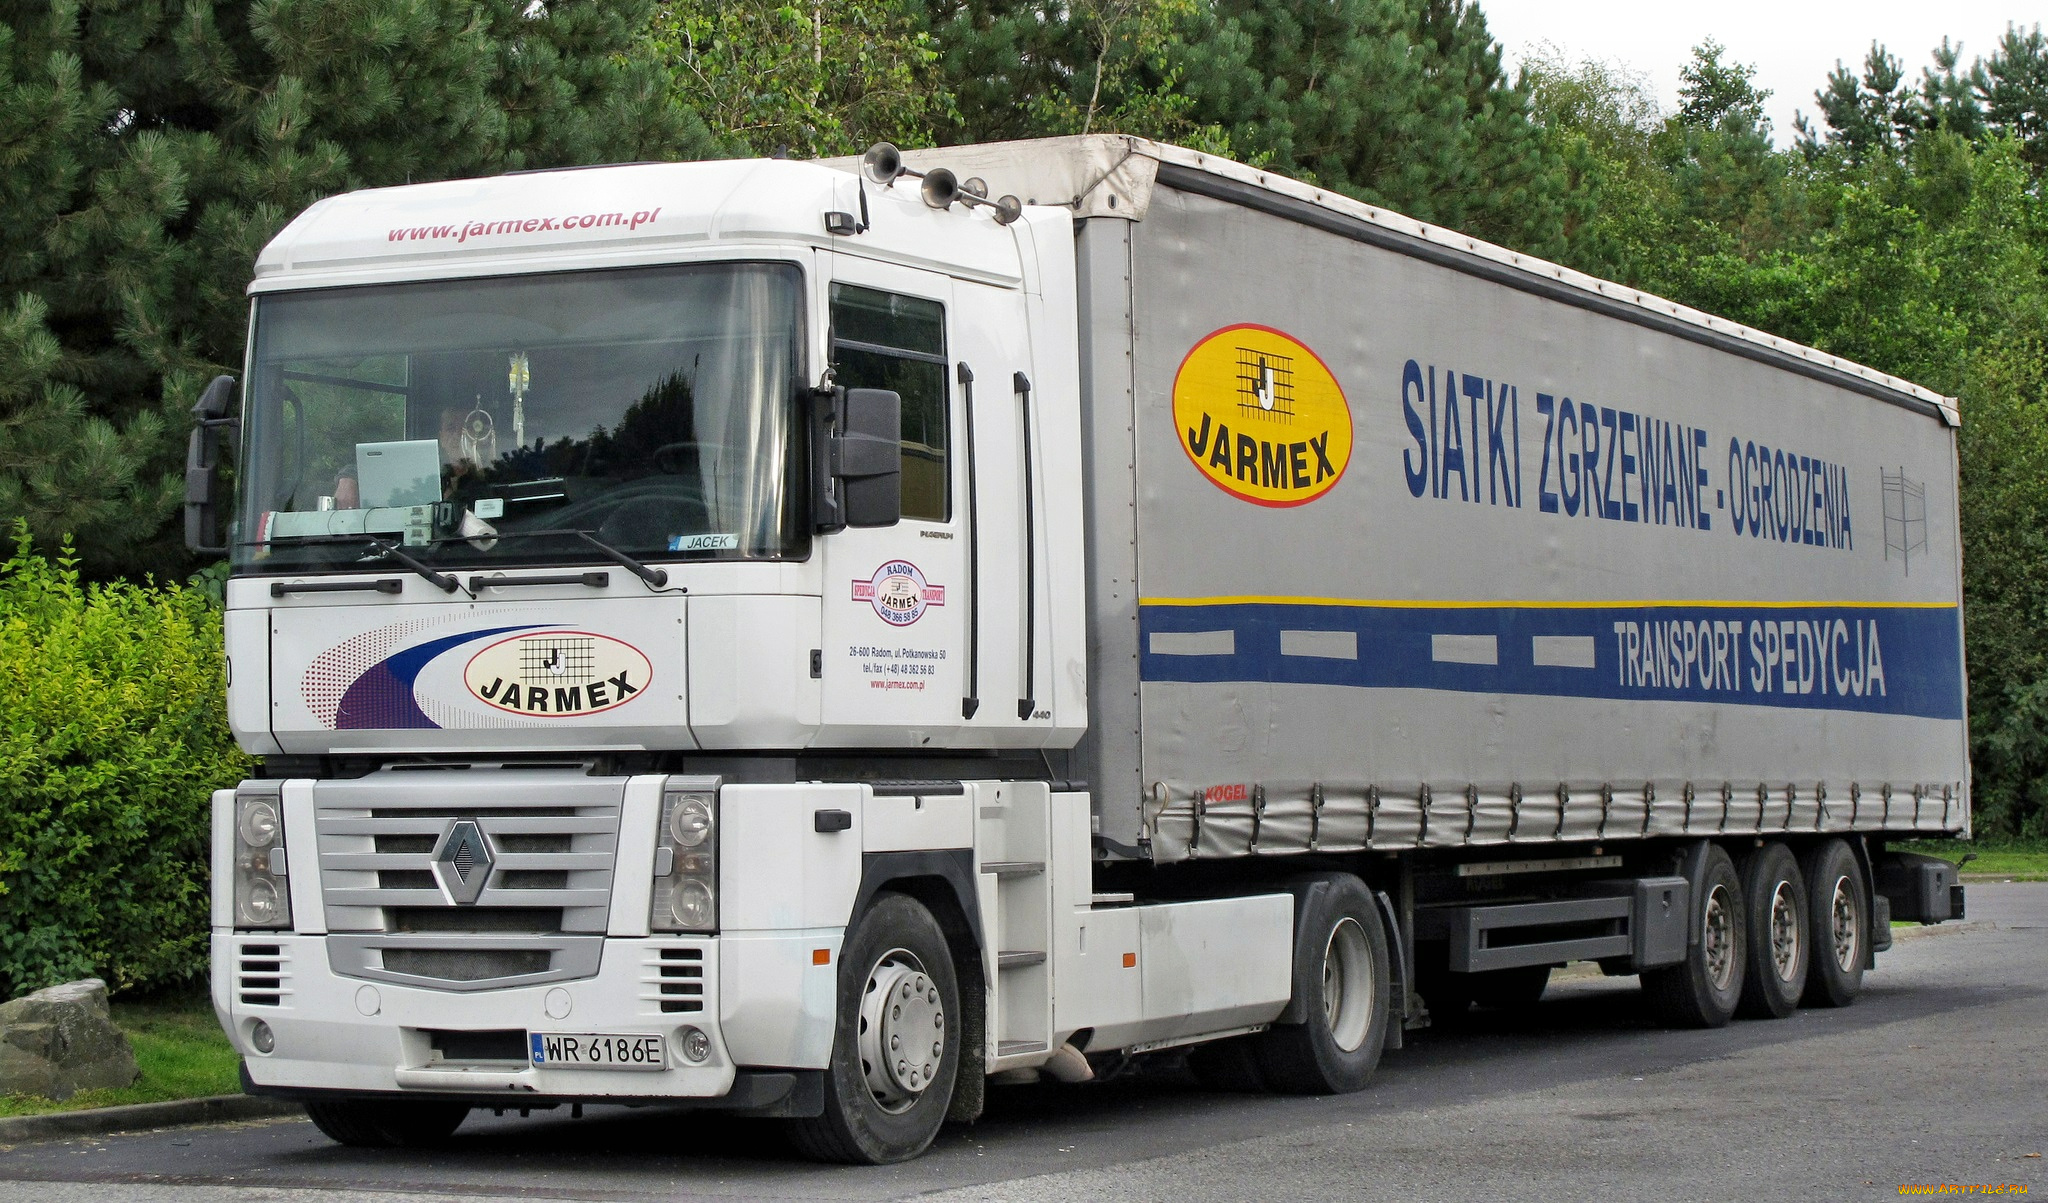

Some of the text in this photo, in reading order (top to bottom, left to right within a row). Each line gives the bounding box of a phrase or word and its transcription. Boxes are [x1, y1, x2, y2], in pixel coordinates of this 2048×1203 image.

[388, 207, 662, 243] www.jarmex.com.pl
[1188, 411, 1335, 489] JARMEX
[1402, 358, 1521, 509] SIATKI
[1536, 392, 1711, 531] ZGRZEWANE
[1729, 436, 1853, 550] OGRODZENIA
[687, 536, 729, 549] JACEK
[887, 564, 913, 577] RADOM
[854, 584, 875, 597] SPEDYCJA
[922, 589, 944, 601] TRANSPORT
[881, 593, 919, 608] JARMEX
[880, 606, 891, 620] 048
[892, 612, 902, 622] 366
[849, 646, 870, 657] 26-600
[872, 647, 893, 659] Radom,
[902, 648, 938, 660] Potkanowska
[939, 649, 946, 660] 50
[1614, 617, 1886, 697] TRANSPORT SPEDYCJA
[883, 663, 900, 676] (+48)
[901, 664, 908, 674] 48
[480, 669, 638, 712] JARMEX
[870, 679, 925, 692] www.jarmex.com.pl
[534, 1051, 543, 1059] PL
[546, 1037, 661, 1063] WR 6186E
